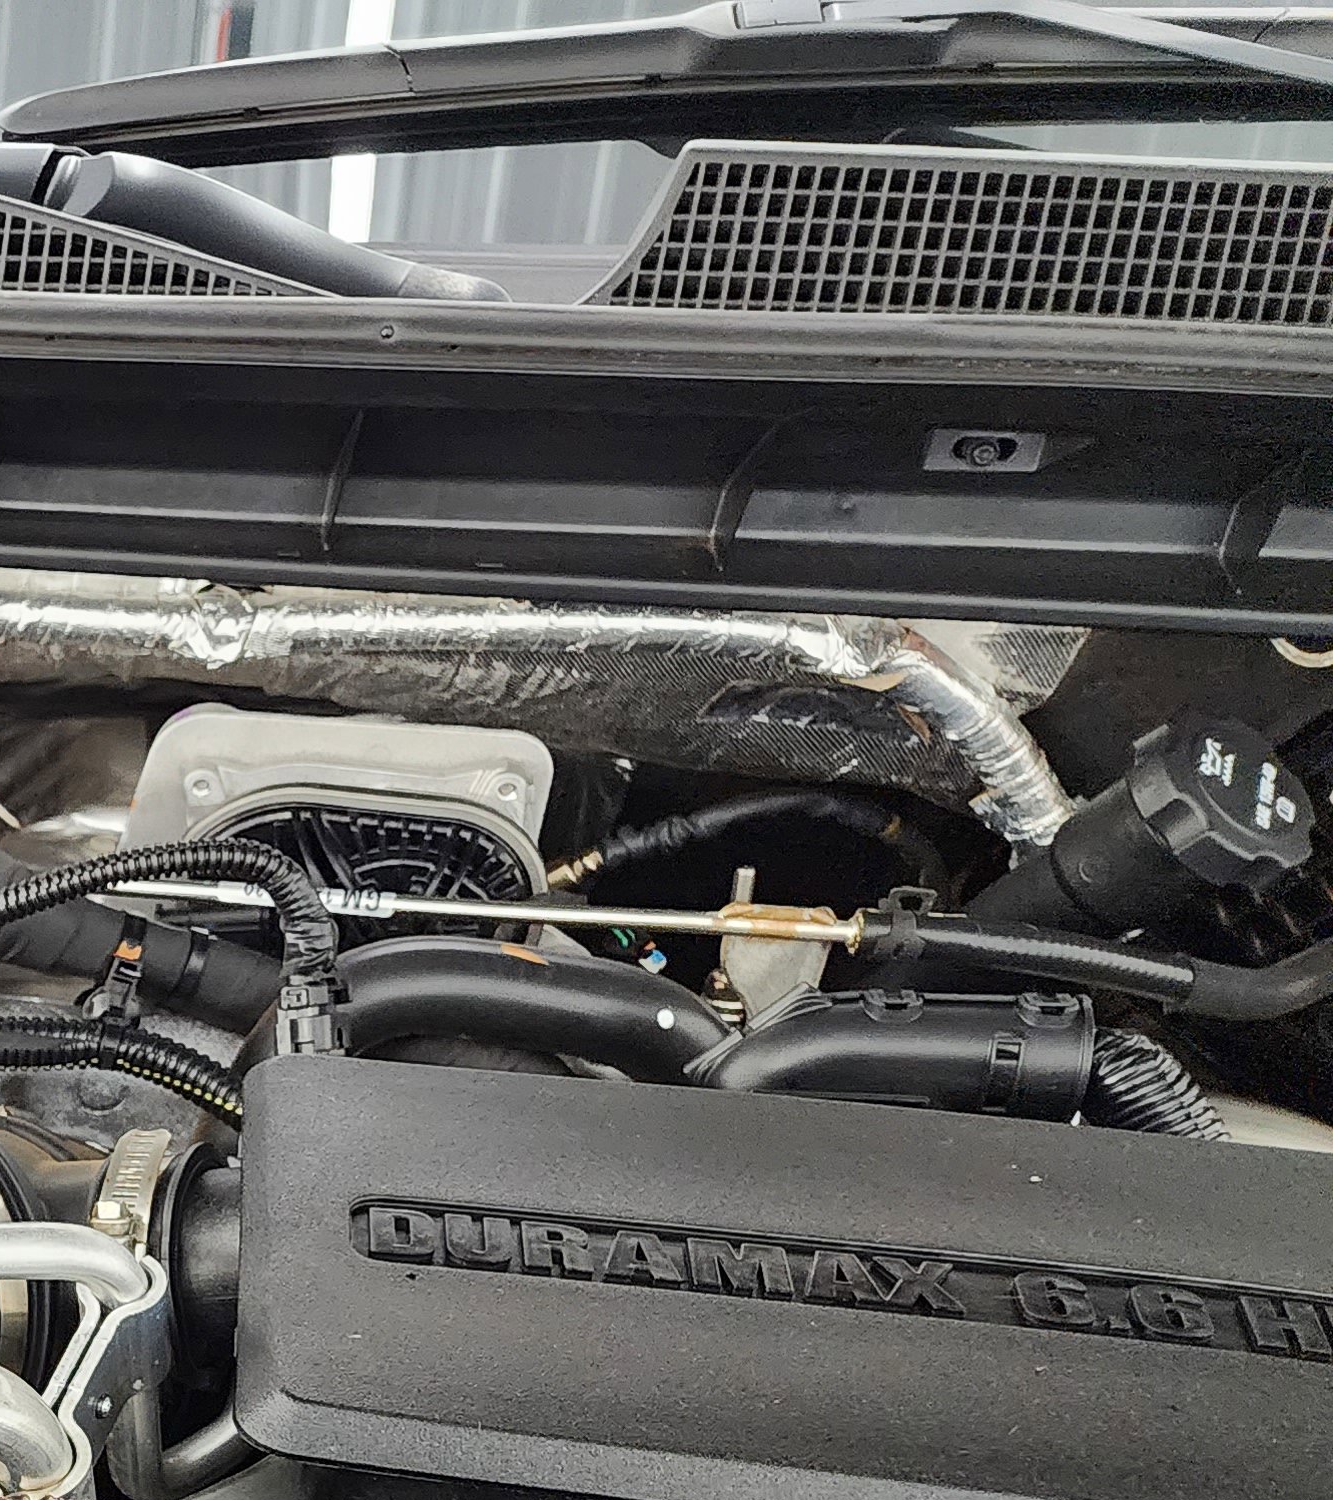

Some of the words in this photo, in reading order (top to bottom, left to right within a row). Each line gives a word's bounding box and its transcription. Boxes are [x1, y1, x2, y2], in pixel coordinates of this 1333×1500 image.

[367, 1206, 967, 1315] DURAMAX
[1013, 1269, 1216, 1340] 6.6
[1237, 1295, 1333, 1357] H
